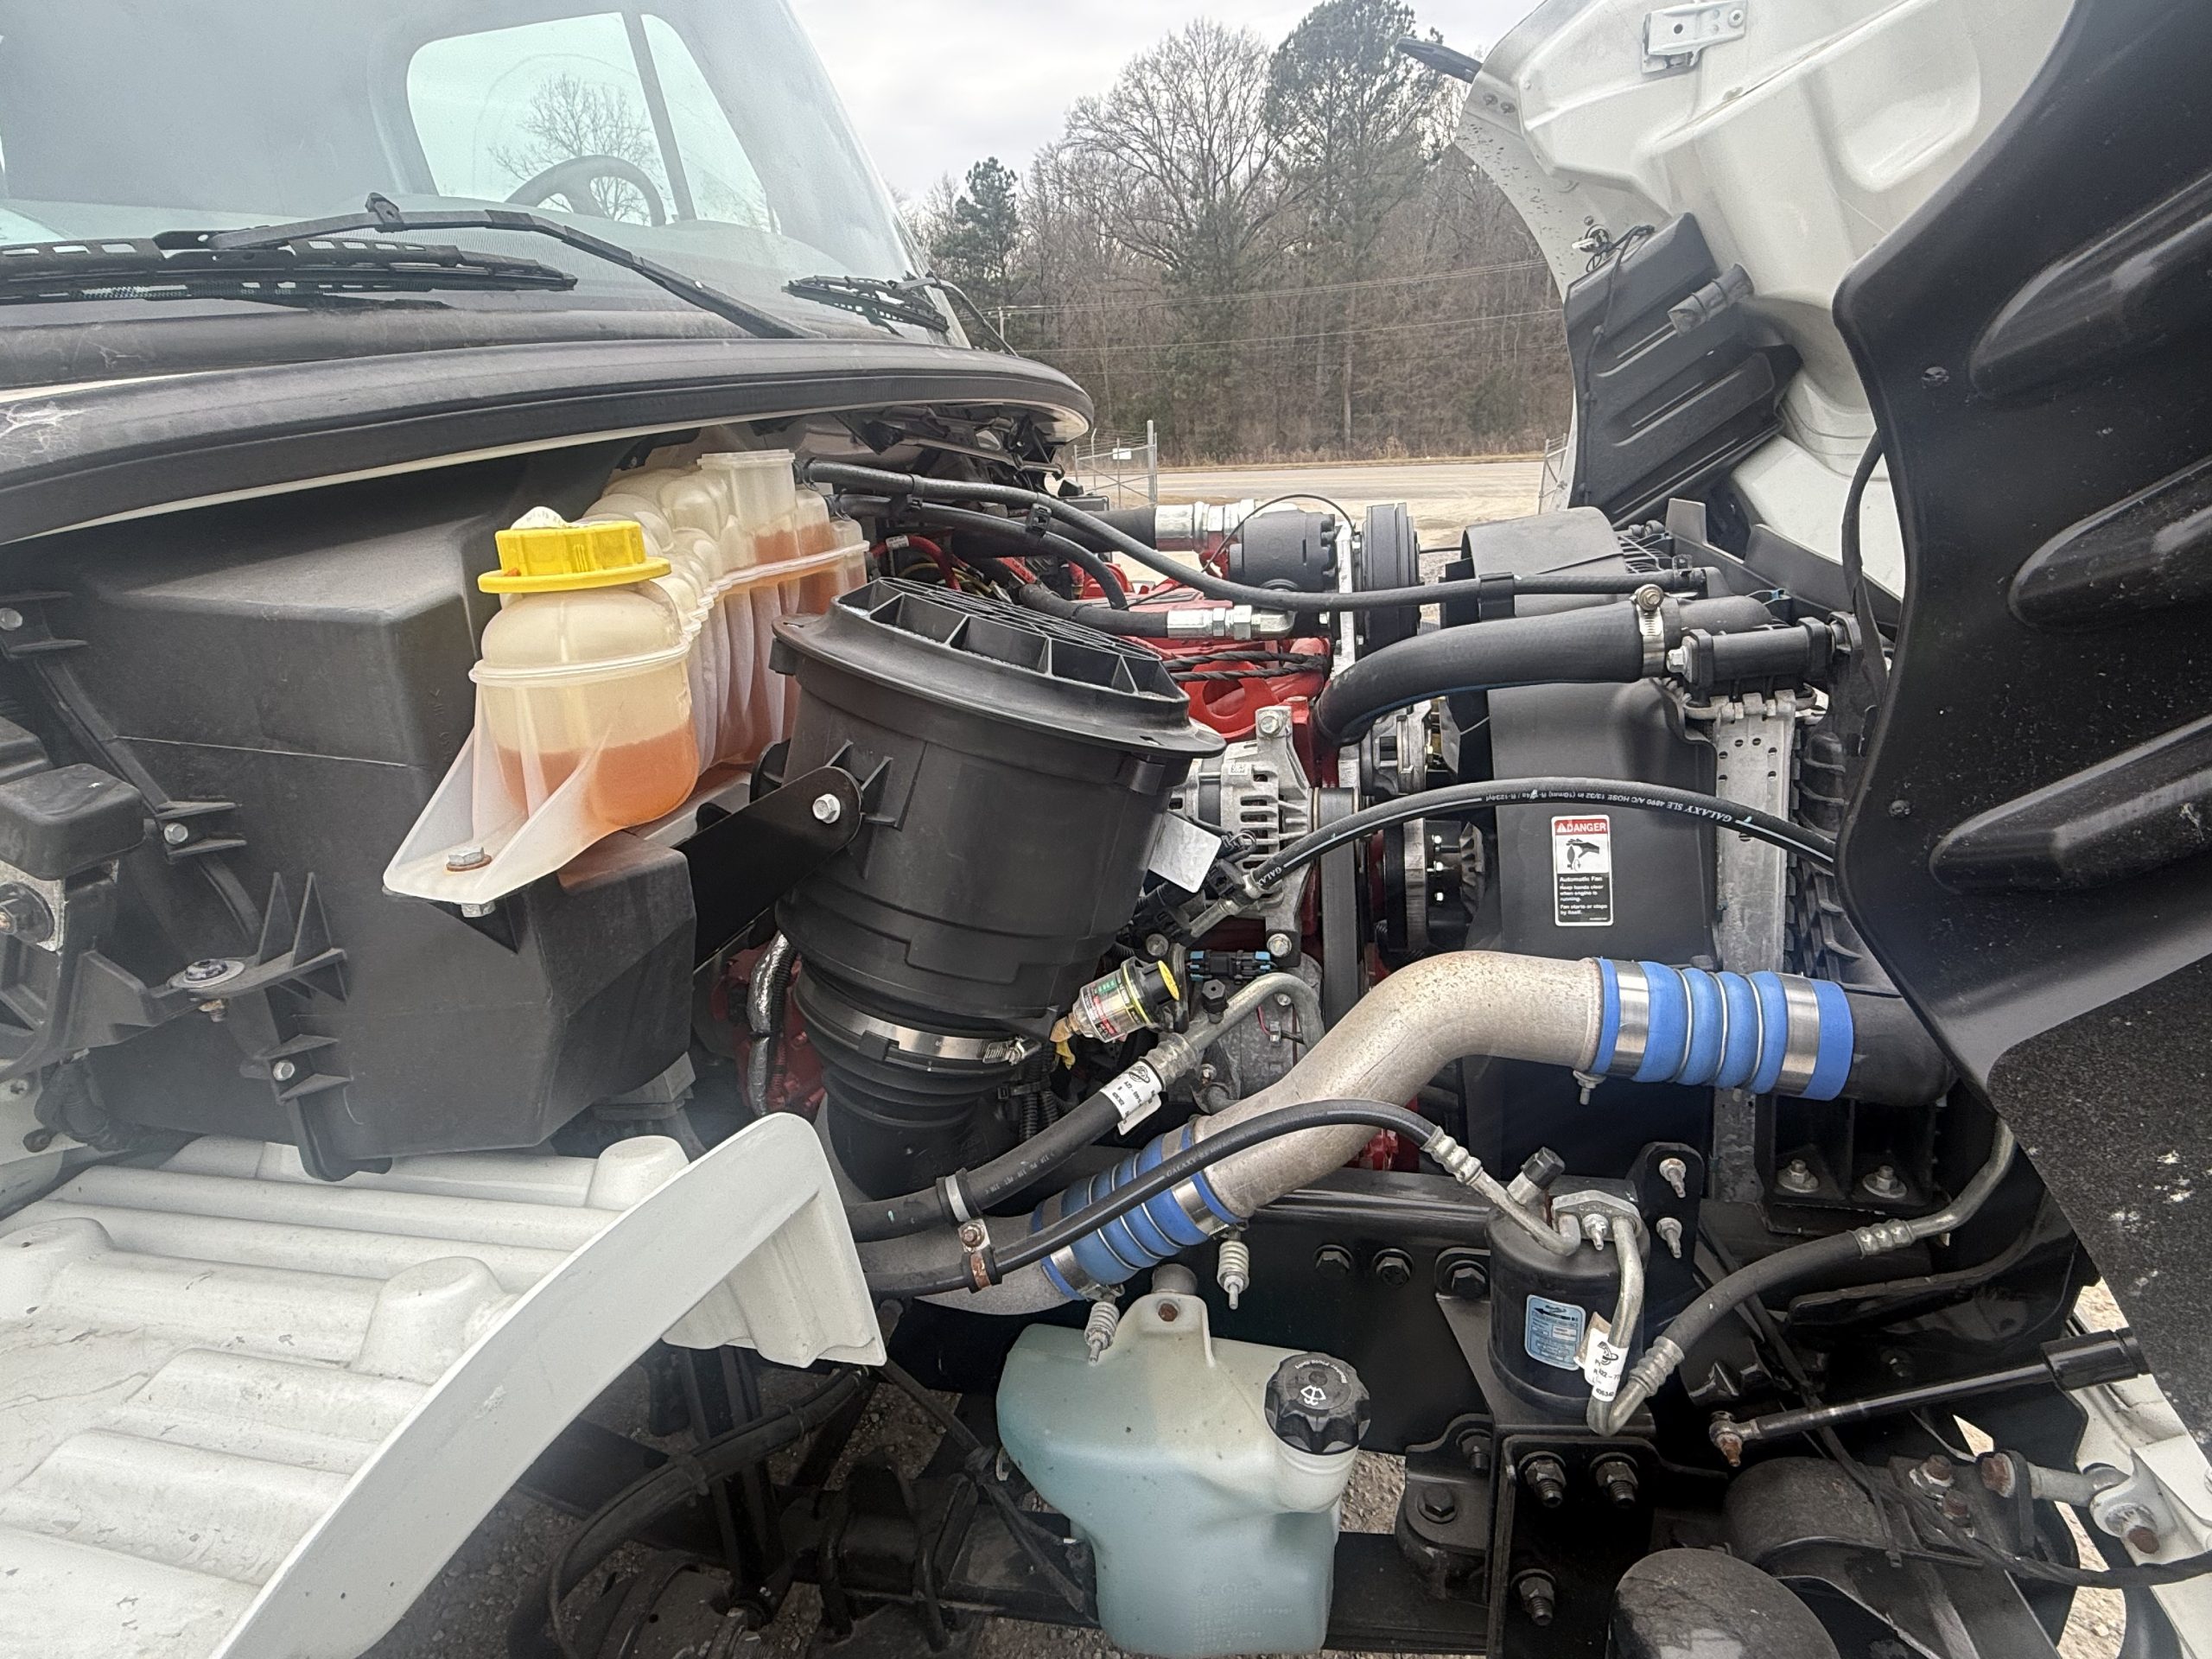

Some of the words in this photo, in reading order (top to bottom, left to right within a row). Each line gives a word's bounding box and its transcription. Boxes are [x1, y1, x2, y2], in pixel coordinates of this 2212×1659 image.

[1548, 791, 1576, 799] (10mm)
[1666, 801, 1684, 811] SLE
[1684, 805, 1732, 823] GALAXY
[1567, 823, 1606, 833] DANGER
[1166, 1156, 1198, 1177] GALAXY
